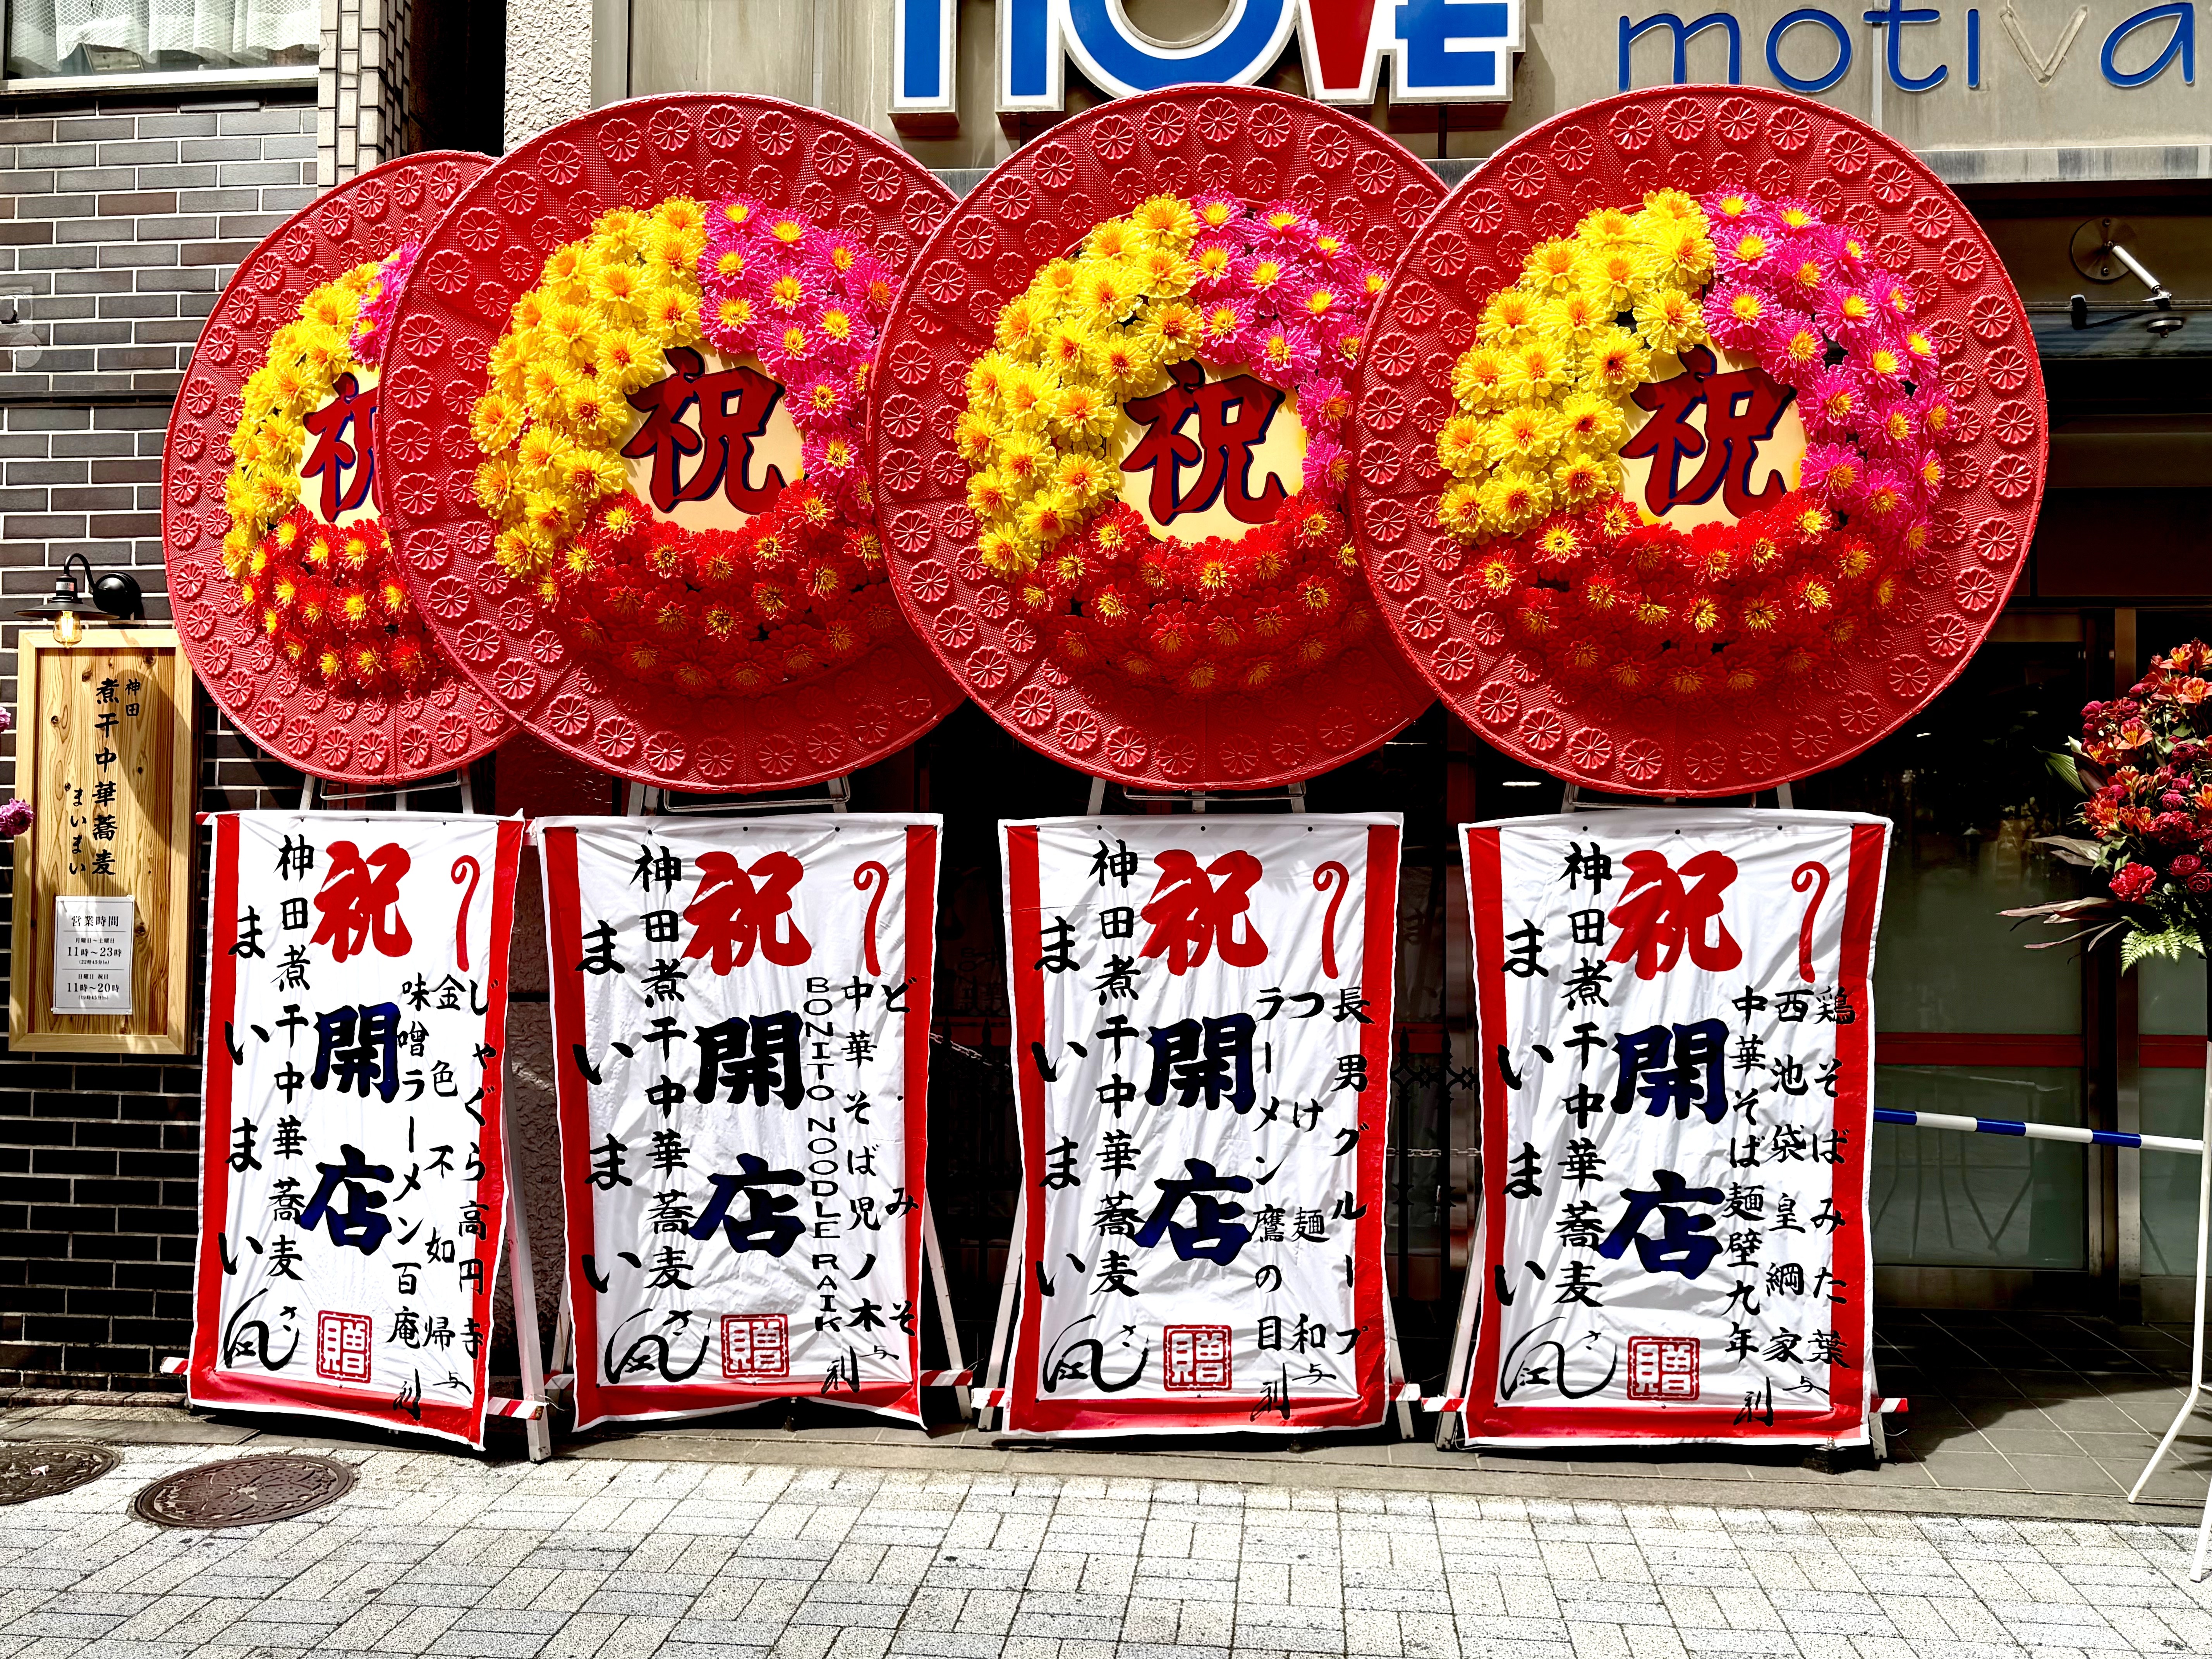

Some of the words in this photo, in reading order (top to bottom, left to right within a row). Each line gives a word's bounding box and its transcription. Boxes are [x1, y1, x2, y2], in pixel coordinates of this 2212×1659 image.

[620, 347, 787, 514] 祝
[1119, 358, 1288, 526] 祝
[1619, 345, 1799, 517] 祝
[69, 787, 87, 876] まいまい
[91, 677, 119, 876] 煮干中華蕎麦
[124, 678, 141, 717] 神田
[72, 916, 119, 927] 営業時間
[269, 834, 314, 1280] 神田煮干中華蕎麦
[627, 844, 696, 1290] 神田煮干中華蕎麦
[803, 977, 835, 1101] BONITO
[1087, 838, 1142, 1297] 神田煮干中華蕎麦
[1552, 841, 1613, 1307] 神田煮干中華蕎麦
[386, 972, 430, 1349] 味噌ラーメン百庵
[422, 974, 467, 1356] 金色不如帰
[459, 979, 500, 1359] じゃぐら高円寺
[808, 1117, 841, 1239] NOODLE
[812, 1254, 841, 1333] RAIK
[841, 975, 886, 1332] 中華そば児ノ木
[1252, 987, 1286, 1351] ラーメン鷹の目
[1288, 991, 1331, 1354] つけ麺和
[1329, 986, 1372, 1355] 長男グループ
[1722, 985, 1769, 1364] 中華そば麺壁九年
[1762, 988, 1814, 1365] 西池袋皇綱家
[1806, 986, 1856, 1369] 鶏そばみた葉
